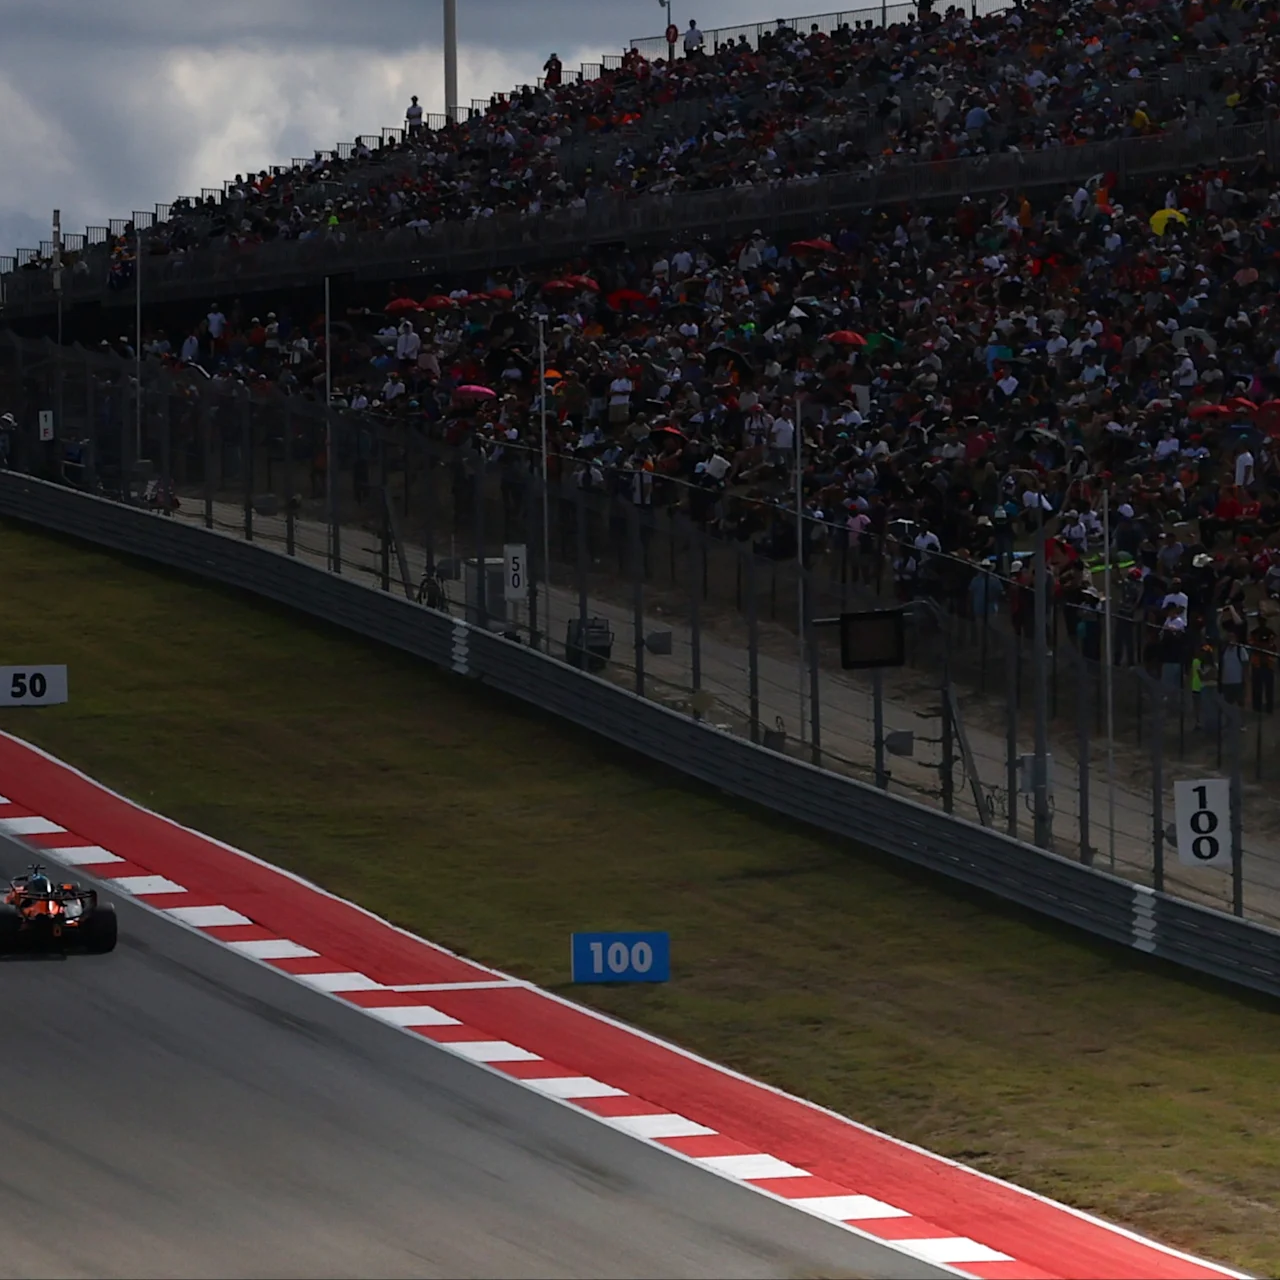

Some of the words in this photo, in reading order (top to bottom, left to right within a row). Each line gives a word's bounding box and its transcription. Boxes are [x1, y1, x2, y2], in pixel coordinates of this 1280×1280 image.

[511, 556, 520, 589] 50
[11, 673, 47, 698] 50
[1190, 786, 1219, 859] 100
[589, 941, 653, 974] 100
